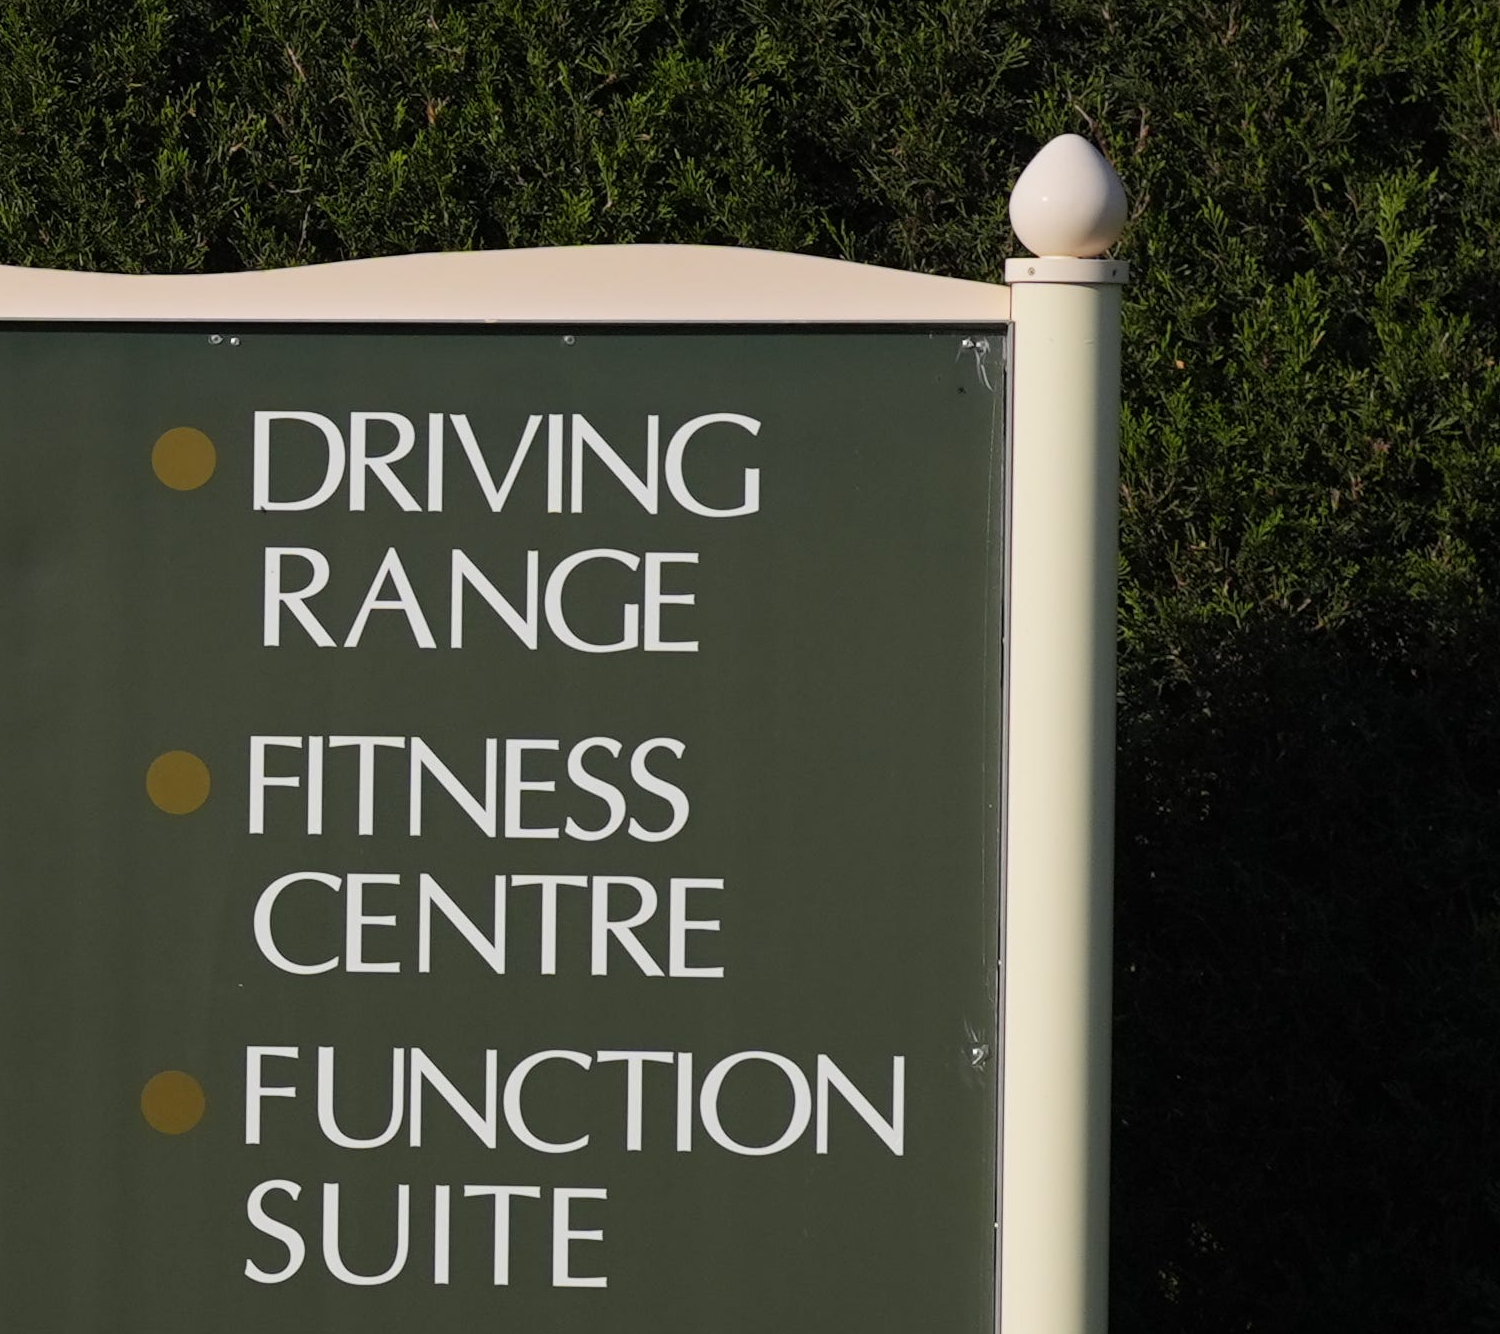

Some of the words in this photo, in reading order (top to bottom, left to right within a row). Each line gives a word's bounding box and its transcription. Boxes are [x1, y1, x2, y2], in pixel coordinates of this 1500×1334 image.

[252, 409, 762, 519] DRIVING
[262, 545, 701, 655] RANGE
[248, 734, 691, 843] FITNESS
[252, 870, 726, 979] CENTRE
[244, 1044, 906, 1157] FUNCTION
[243, 1178, 609, 1289] SUITE
